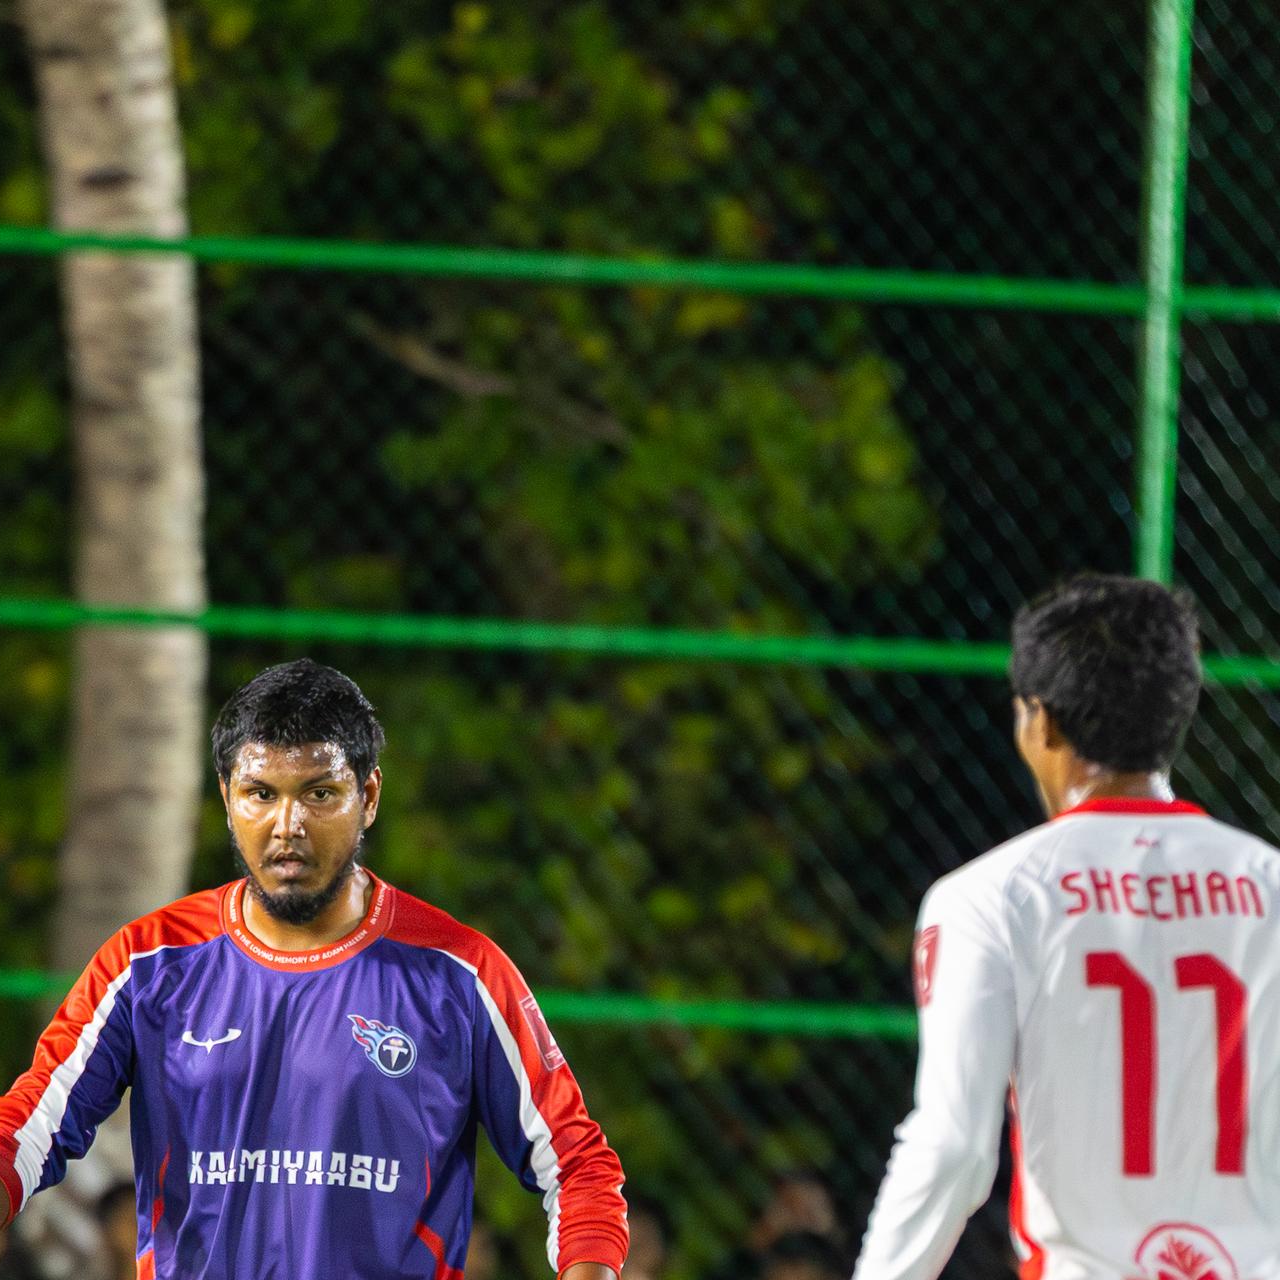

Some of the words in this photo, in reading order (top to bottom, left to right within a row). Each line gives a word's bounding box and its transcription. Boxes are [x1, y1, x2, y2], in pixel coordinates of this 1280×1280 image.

[1060, 867, 1265, 921] SHEEHAN
[240, 934, 251, 948] THE
[249, 943, 273, 962] LOVING
[274, 956, 307, 964] MEMORY
[309, 954, 320, 963] OF
[322, 946, 344, 960] ADAM
[1085, 951, 1247, 1178] 11
